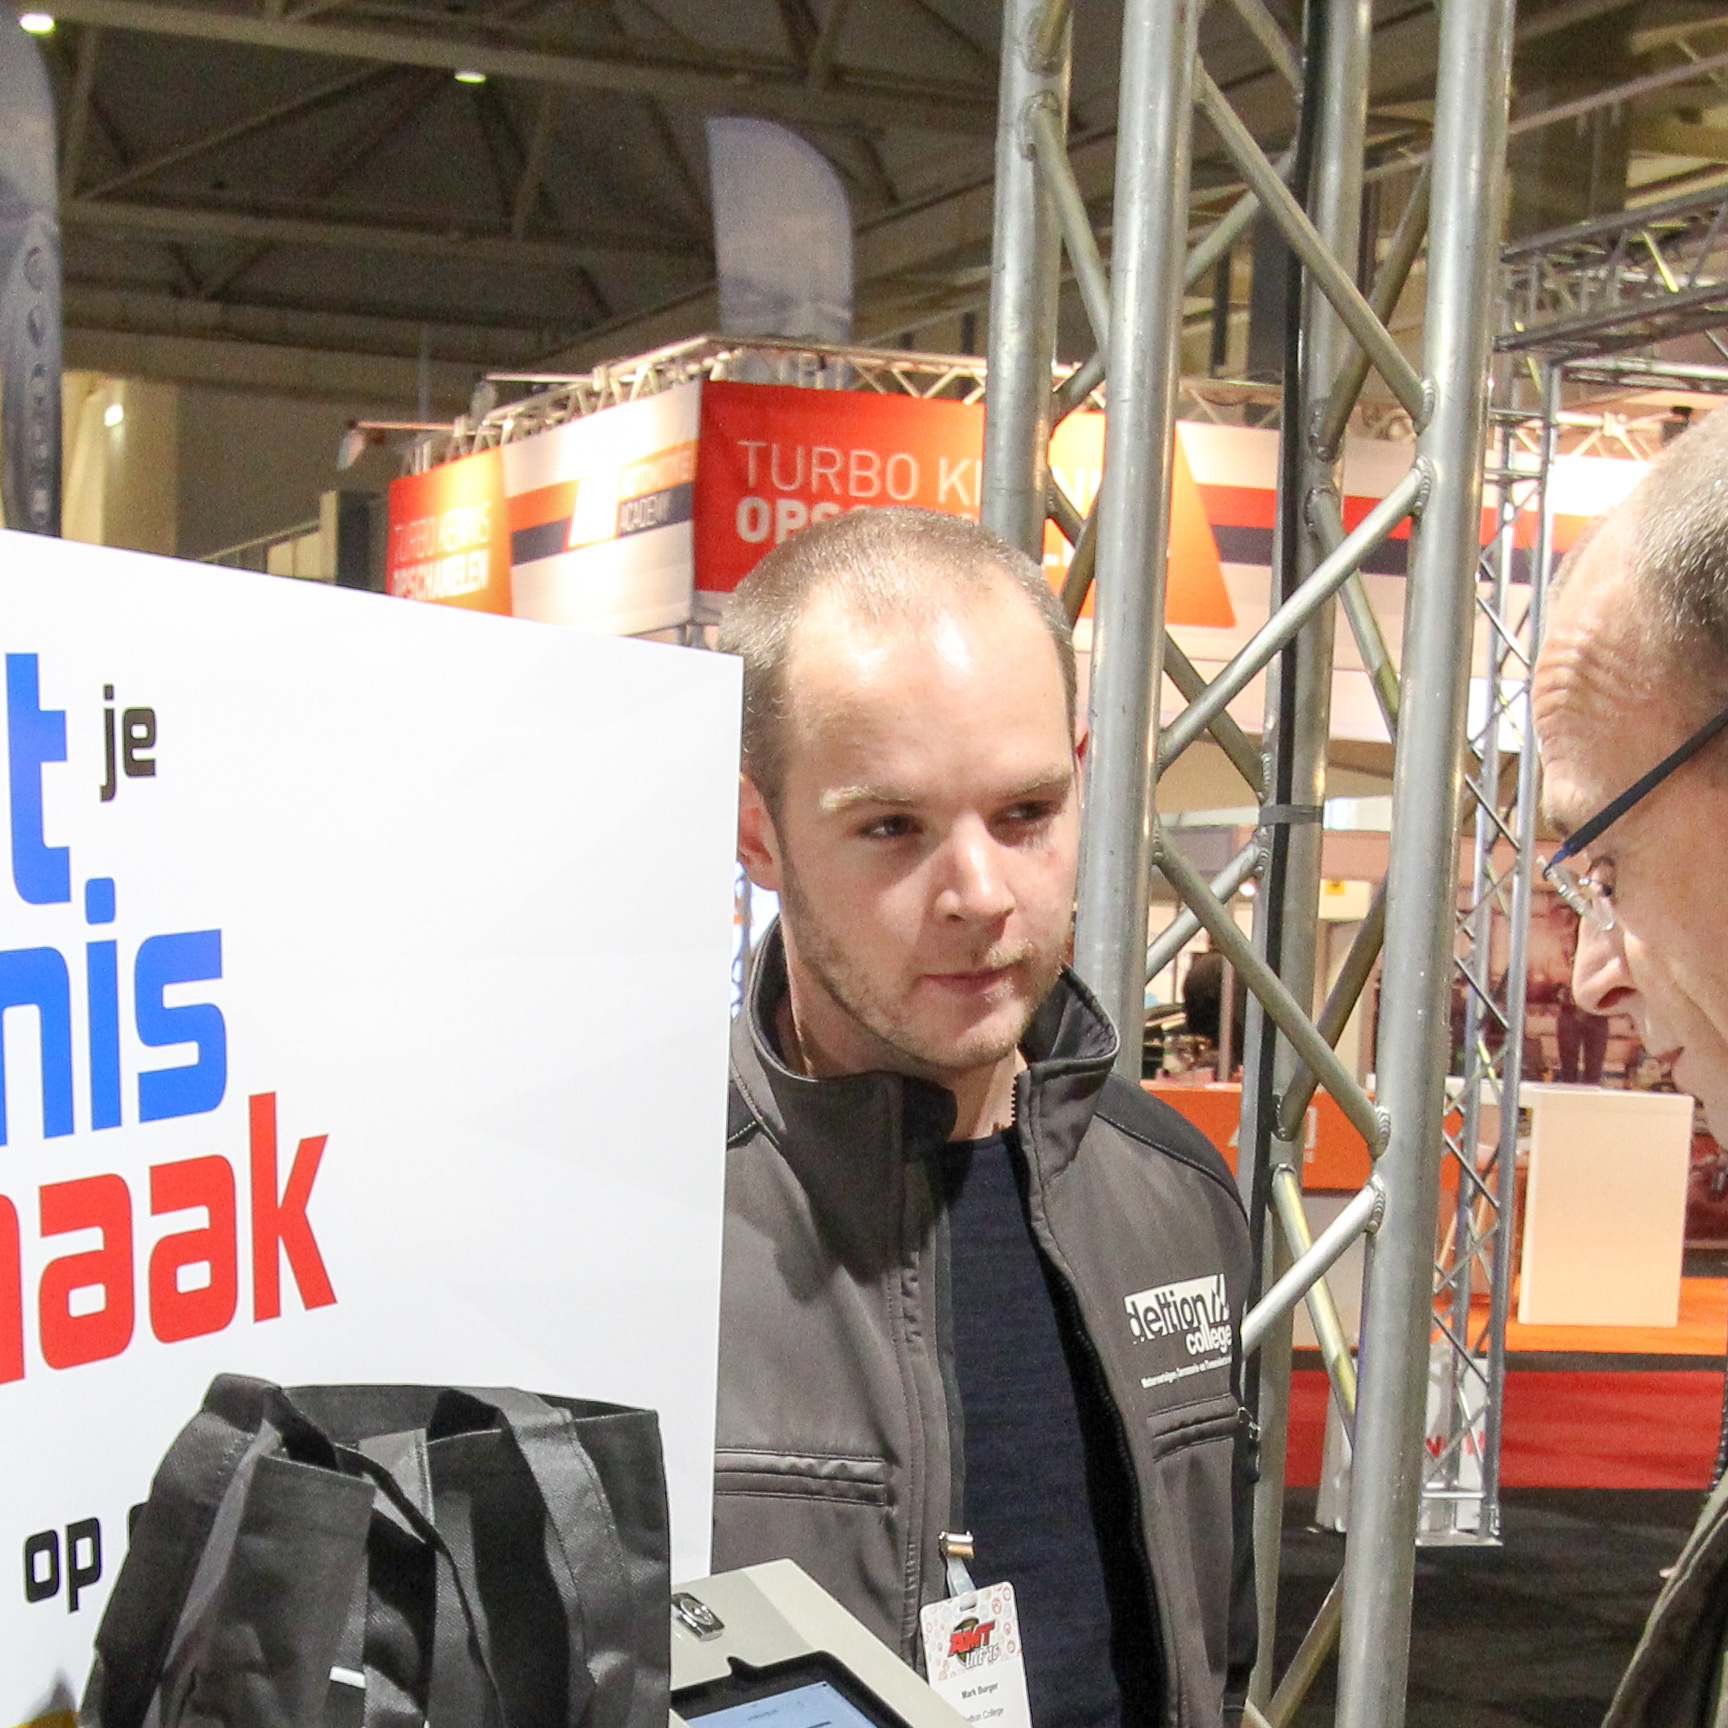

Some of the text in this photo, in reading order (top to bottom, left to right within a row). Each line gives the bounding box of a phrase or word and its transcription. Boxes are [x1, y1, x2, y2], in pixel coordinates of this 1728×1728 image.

[737, 440, 920, 501] TURBO
[99, 683, 157, 803] je
[1185, 1323, 1233, 1356] college
[24, 1516, 103, 1614] op
[947, 1620, 996, 1659] AMT
